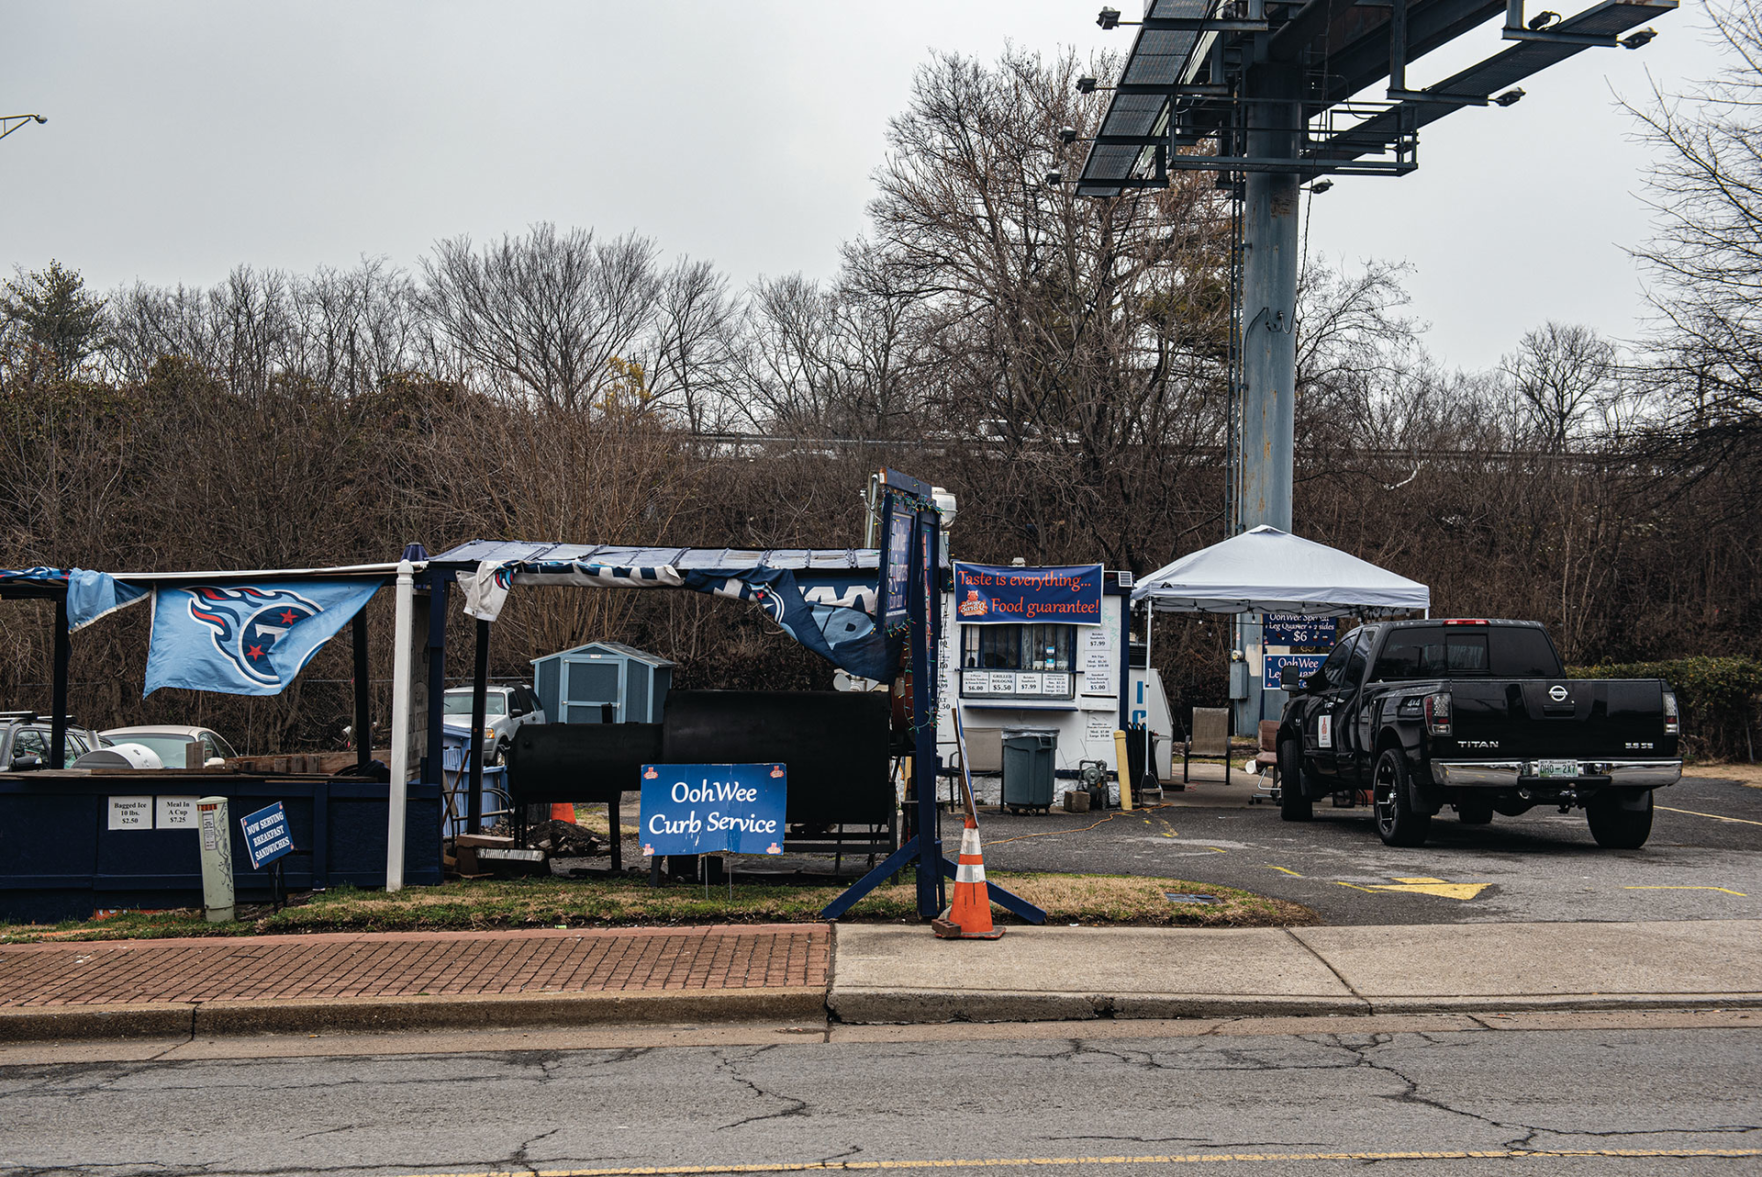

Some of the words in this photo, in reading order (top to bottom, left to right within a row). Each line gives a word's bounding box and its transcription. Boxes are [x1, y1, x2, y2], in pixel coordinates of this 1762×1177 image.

[958, 571, 992, 587] Taste
[996, 573, 1006, 586] is
[1009, 571, 1091, 592] everything...
[991, 596, 1024, 613] Food
[1027, 599, 1099, 618] guarantee!
[1269, 622, 1281, 631] Leg
[1318, 622, 1335, 630] sides
[1293, 630, 1308, 642] $6
[1268, 668, 1282, 678] Le
[671, 779, 757, 803] OohWee
[170, 816, 186, 824] $7.25
[246, 822, 260, 835] NOW
[260, 811, 284, 829] SERVING
[648, 810, 702, 834] Curb
[707, 812, 777, 834] Service
[252, 825, 285, 847] BREAKFAST
[255, 836, 290, 860] SANDWICHES
